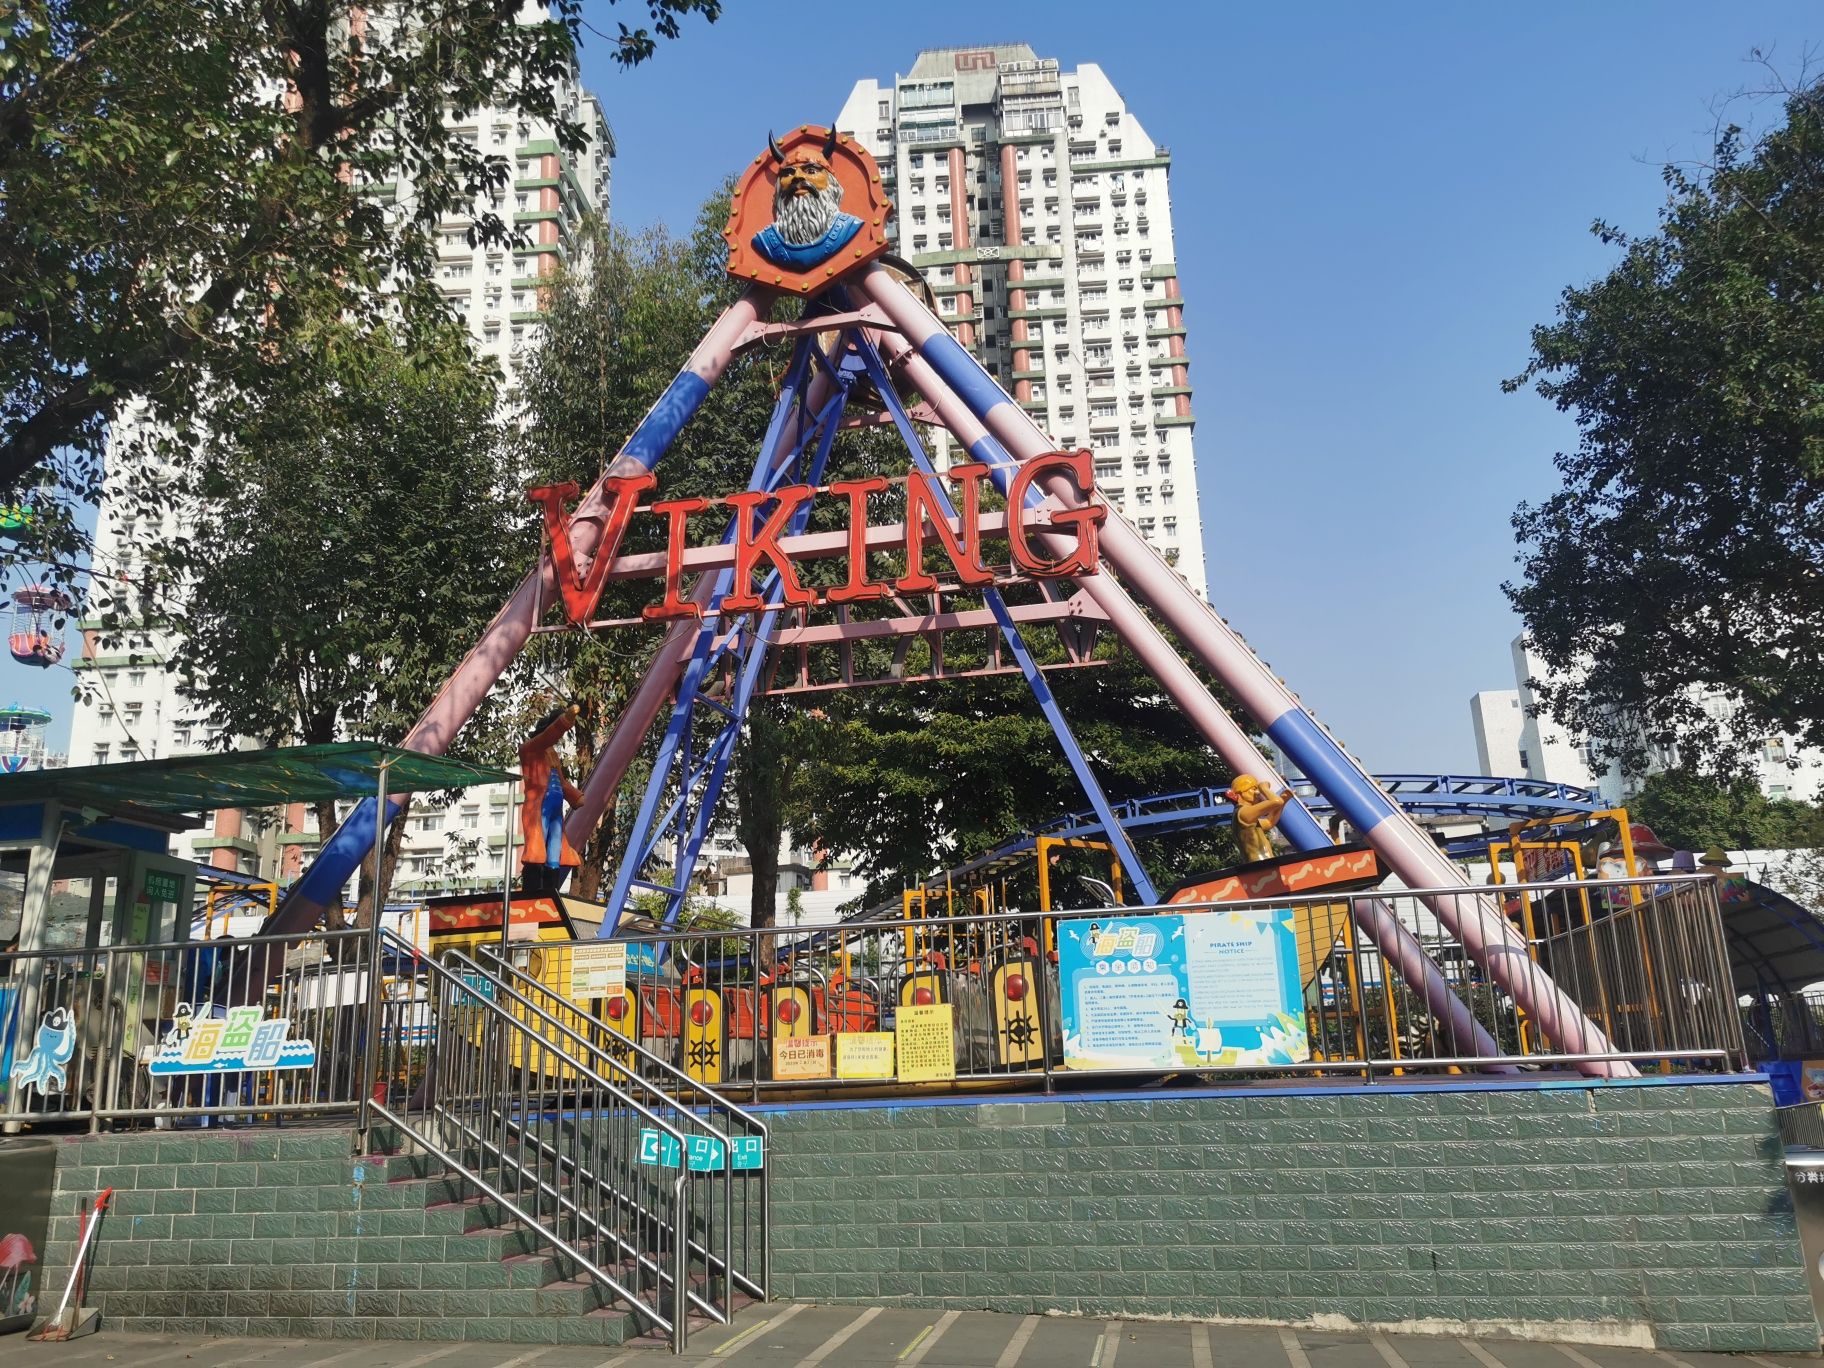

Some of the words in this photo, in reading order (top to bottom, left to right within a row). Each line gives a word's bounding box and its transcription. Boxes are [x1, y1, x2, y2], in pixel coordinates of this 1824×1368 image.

[528, 448, 1107, 625] VIKING
[1095, 928, 1154, 956] 海盗船
[184, 1009, 287, 1061] 海盗船
[779, 1048, 824, 1060] 今日已消毒
